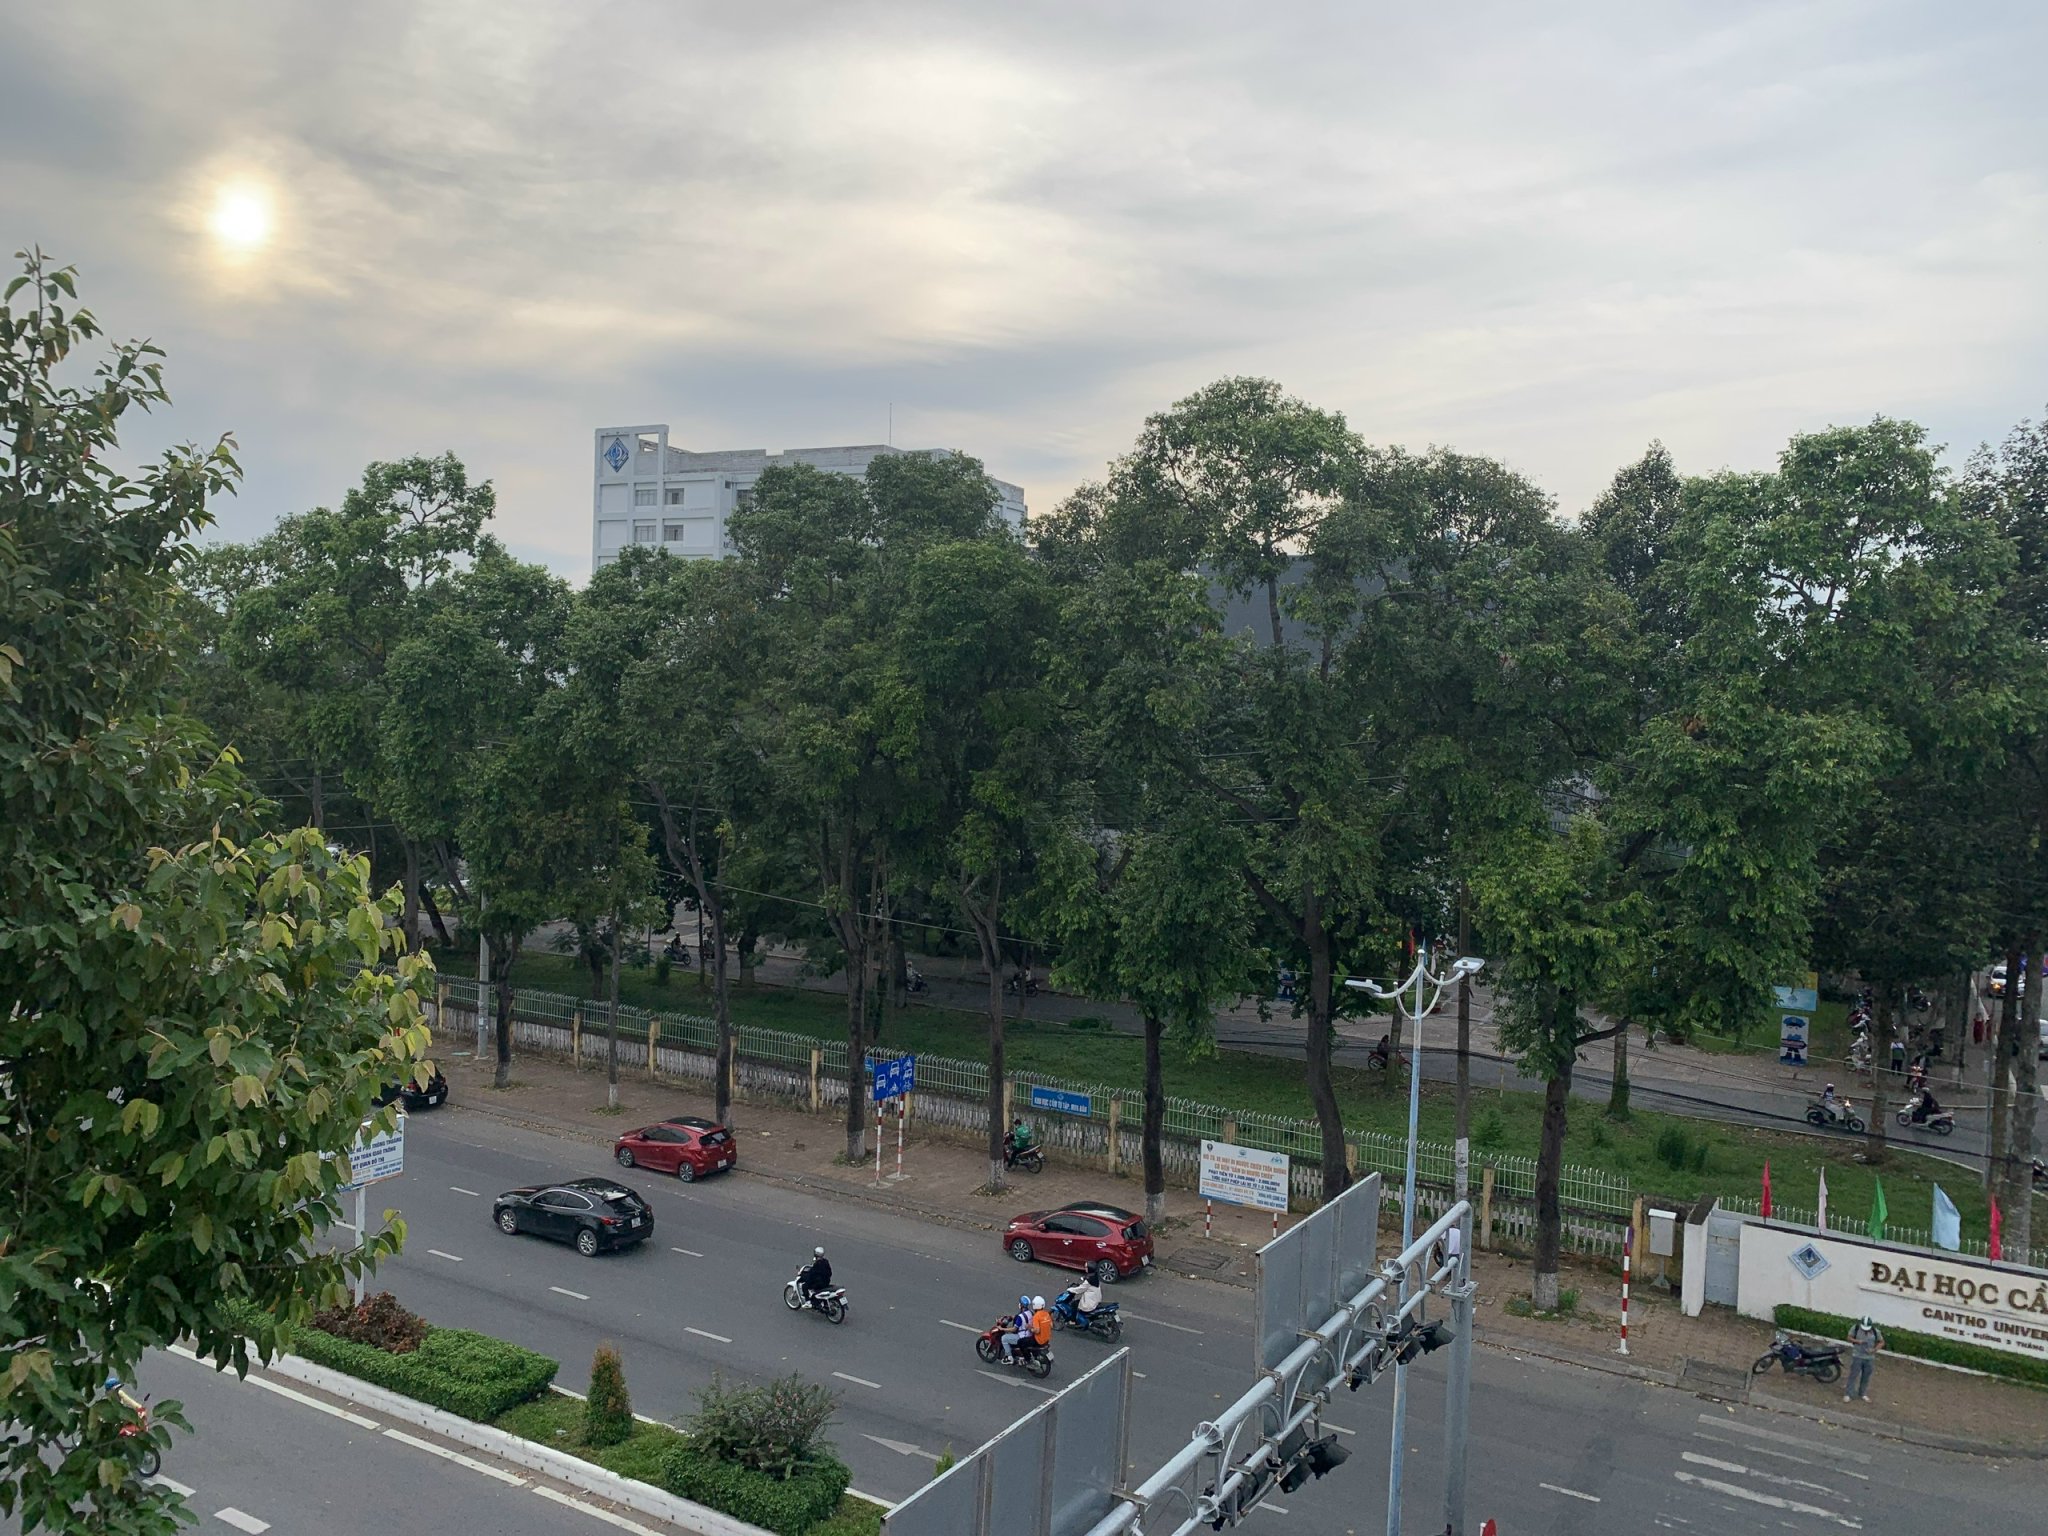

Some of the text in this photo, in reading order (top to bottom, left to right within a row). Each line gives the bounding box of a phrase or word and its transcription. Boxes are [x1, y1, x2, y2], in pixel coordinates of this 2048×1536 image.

[1871, 1262, 2048, 1314] ĐẠI HỌC CẦ
[1922, 1307, 1987, 1328] CANTHO
